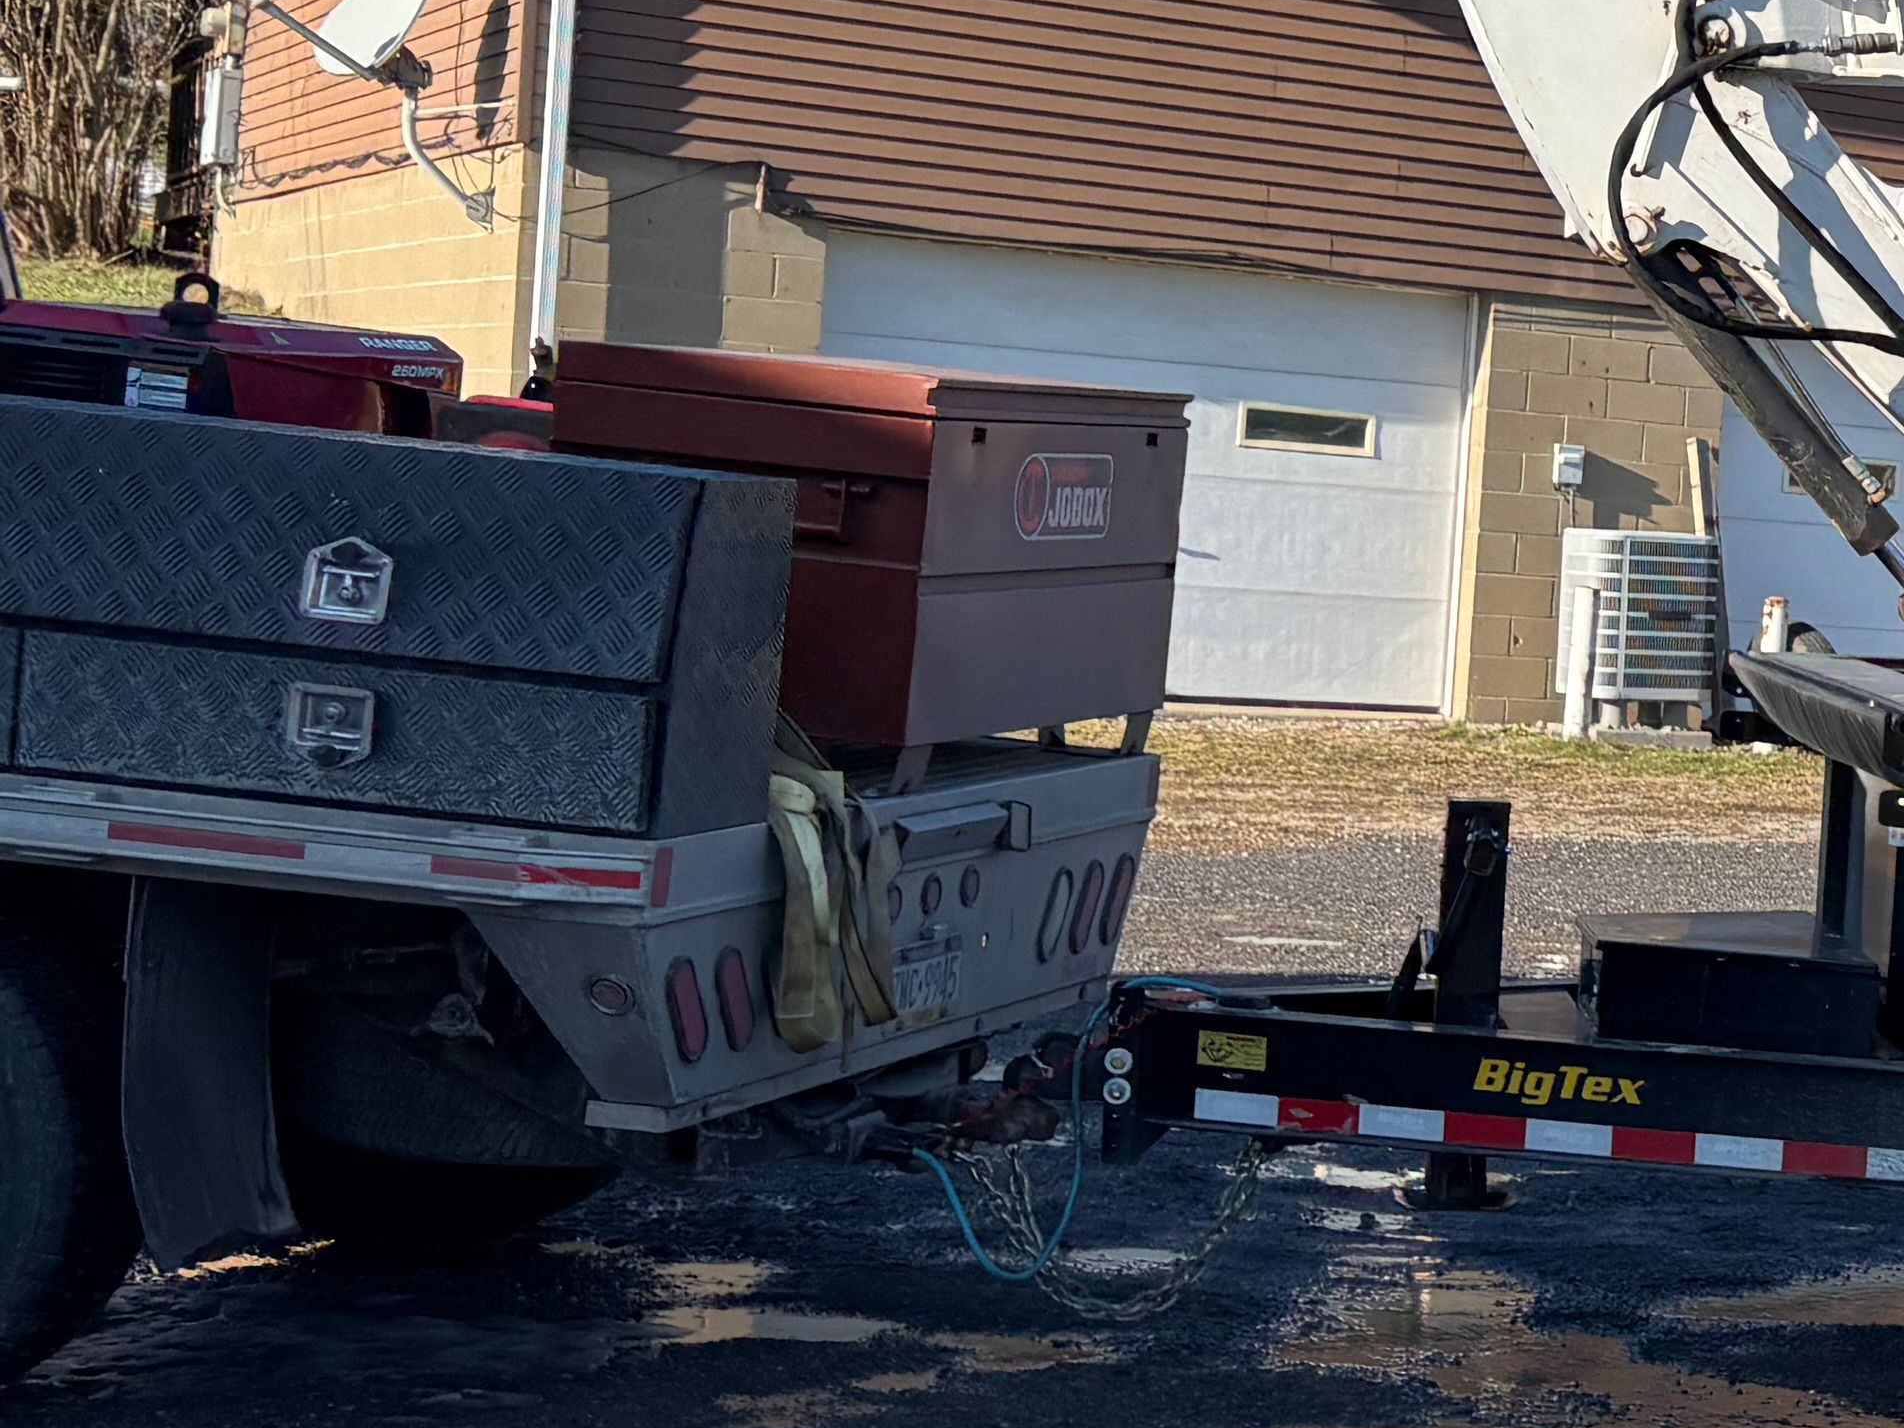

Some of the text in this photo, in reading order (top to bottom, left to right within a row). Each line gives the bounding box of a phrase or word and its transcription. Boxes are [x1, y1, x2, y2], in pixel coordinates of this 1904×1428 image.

[359, 337, 438, 351] RANGER
[1048, 487, 1108, 527] JOBOX
[1472, 1057, 1646, 1106] BigTex
